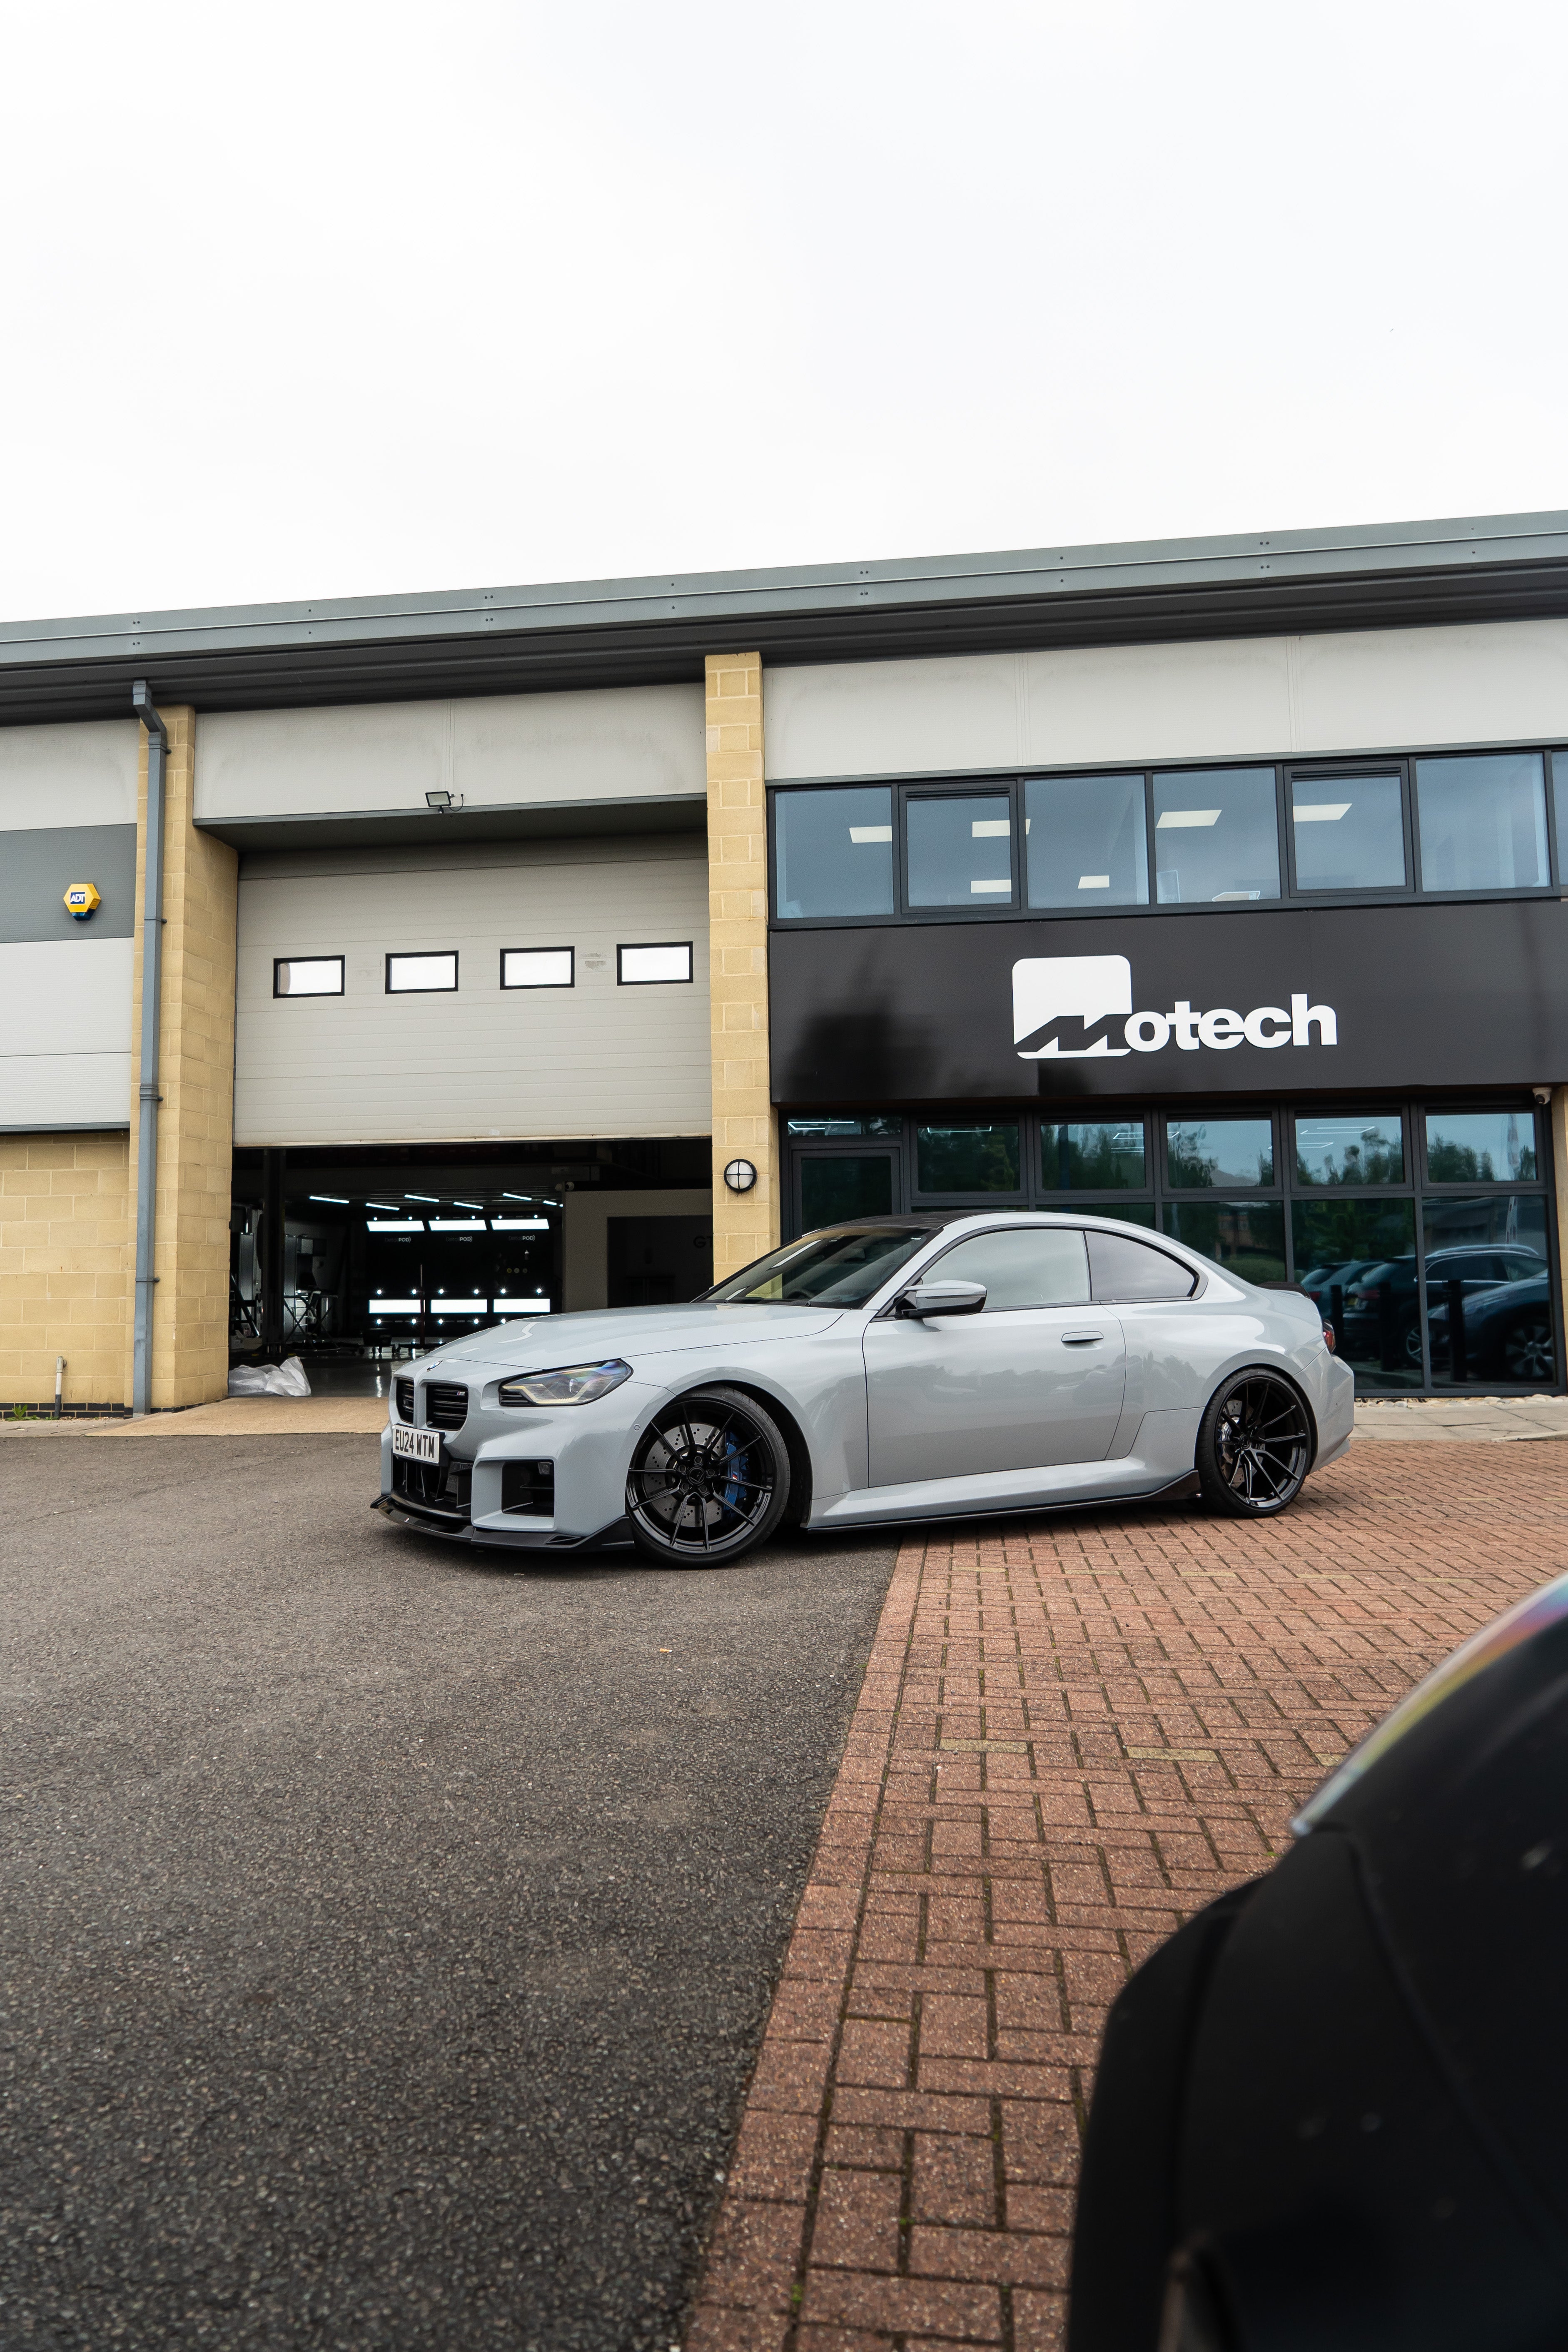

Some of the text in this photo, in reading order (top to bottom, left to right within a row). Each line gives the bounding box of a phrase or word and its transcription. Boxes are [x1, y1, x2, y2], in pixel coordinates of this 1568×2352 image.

[70, 893, 85, 903] ADT
[395, 1429, 434, 1458] EU24 WTM
